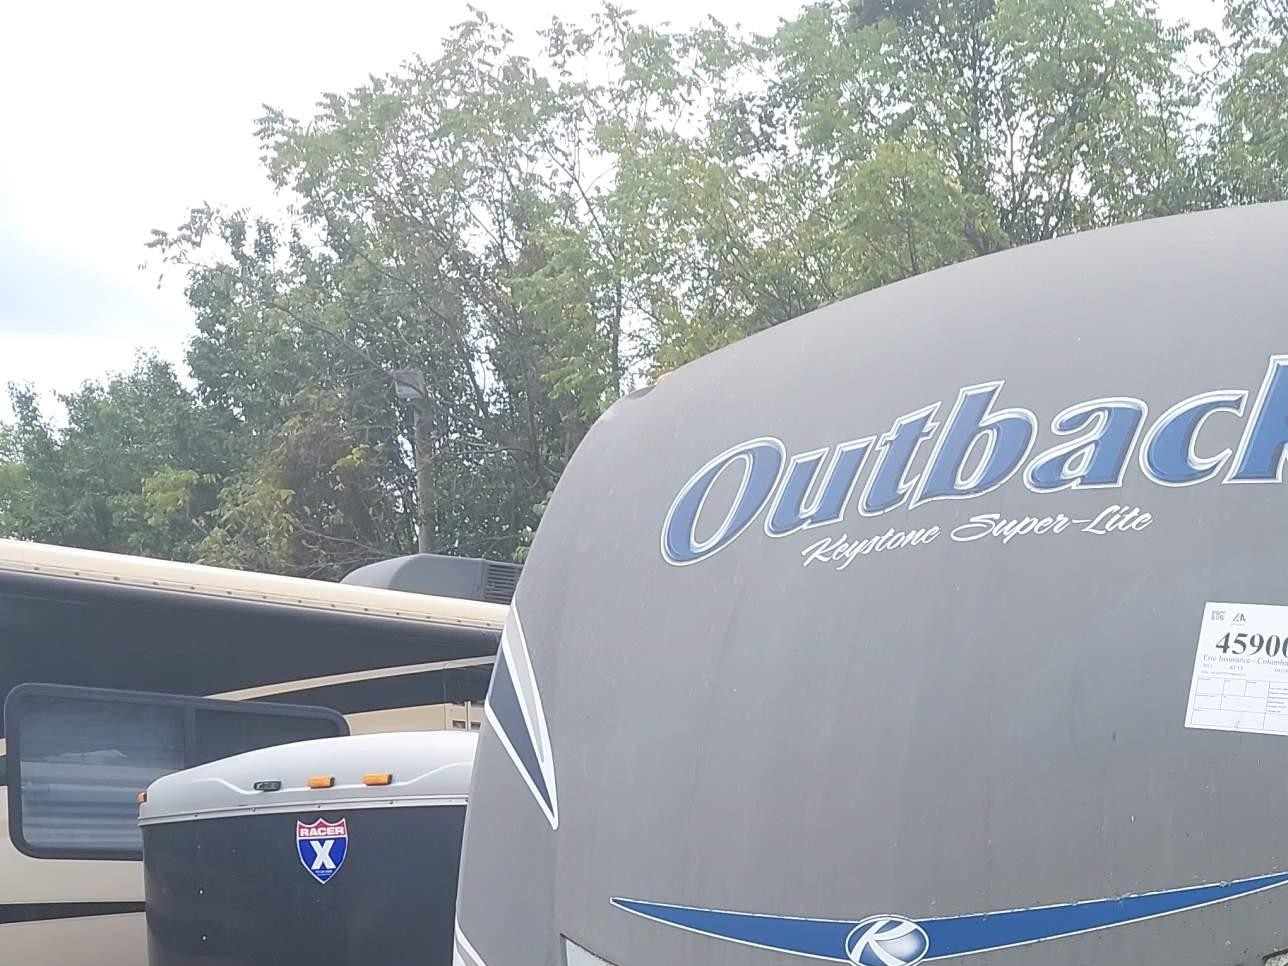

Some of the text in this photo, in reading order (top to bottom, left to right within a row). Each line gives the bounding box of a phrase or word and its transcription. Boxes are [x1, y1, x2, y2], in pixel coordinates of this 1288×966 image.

[802, 504, 1154, 570] Keystone Super-Lite
[299, 826, 345, 837] RACER
[309, 839, 337, 870] X
